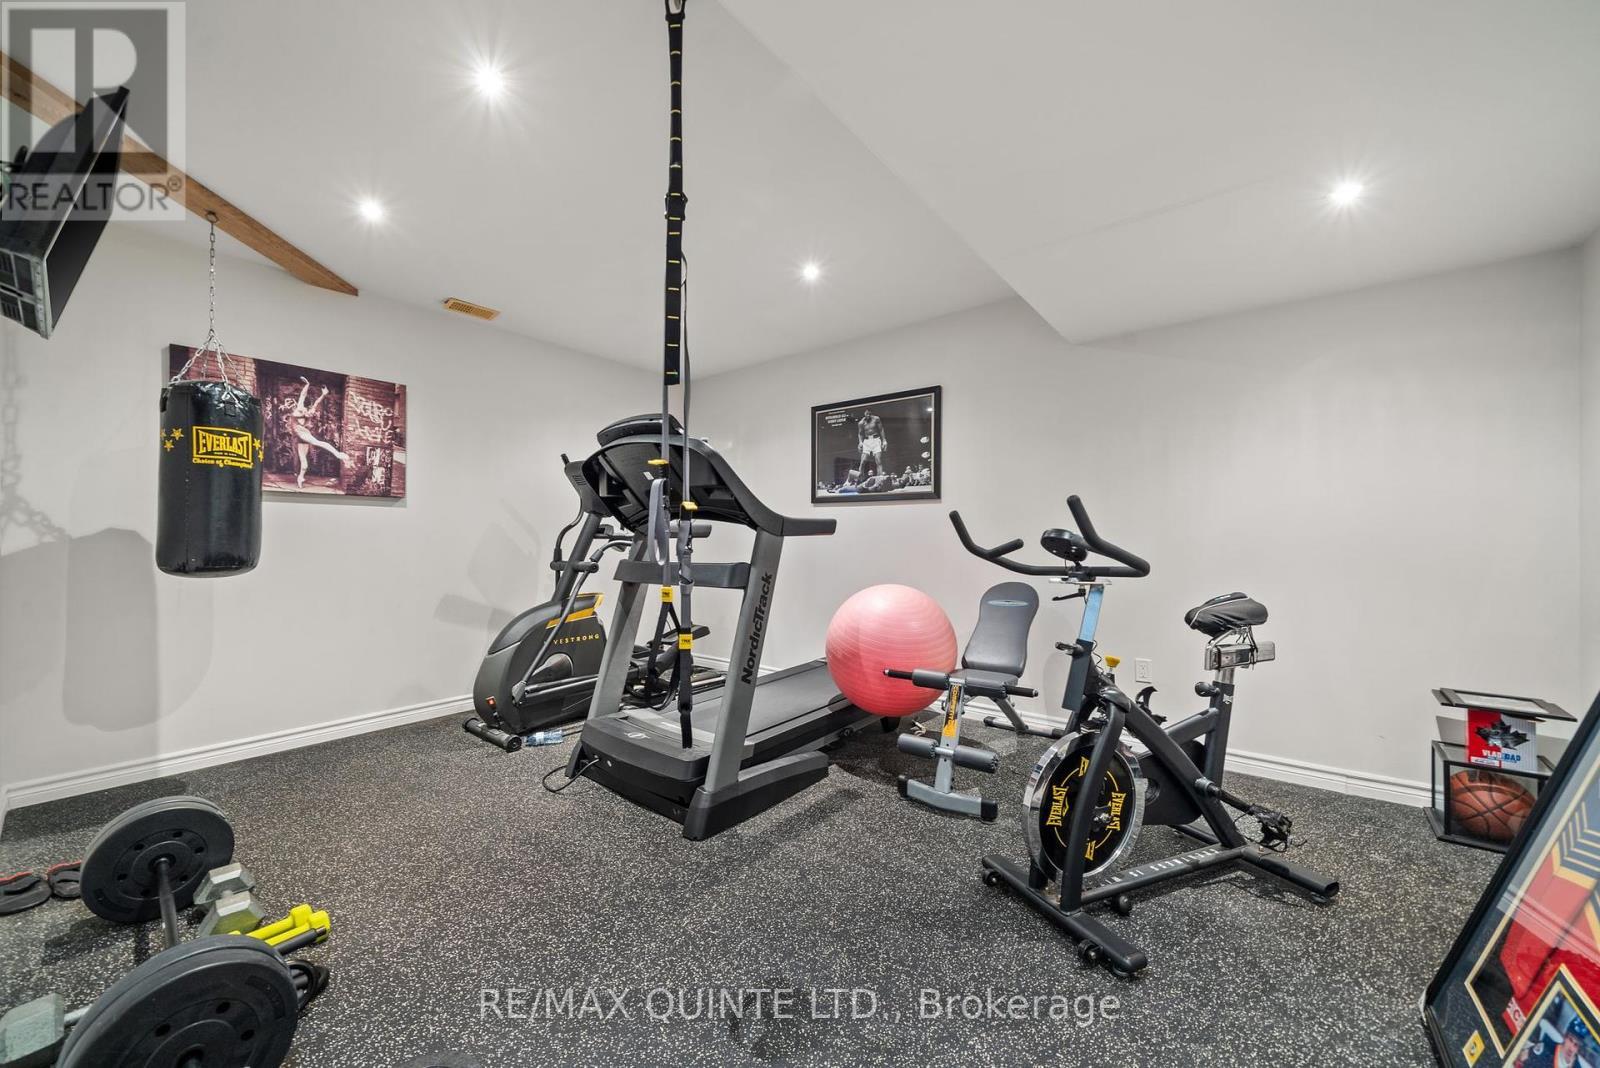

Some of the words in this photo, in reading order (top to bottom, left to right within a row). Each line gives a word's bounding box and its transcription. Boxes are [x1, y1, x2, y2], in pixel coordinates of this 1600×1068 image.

[198, 430, 248, 458] EVERLAST
[544, 633, 600, 645] VESTRONG
[741, 570, 773, 684] NordicTrack
[1046, 785, 1069, 826] EVERLAST
